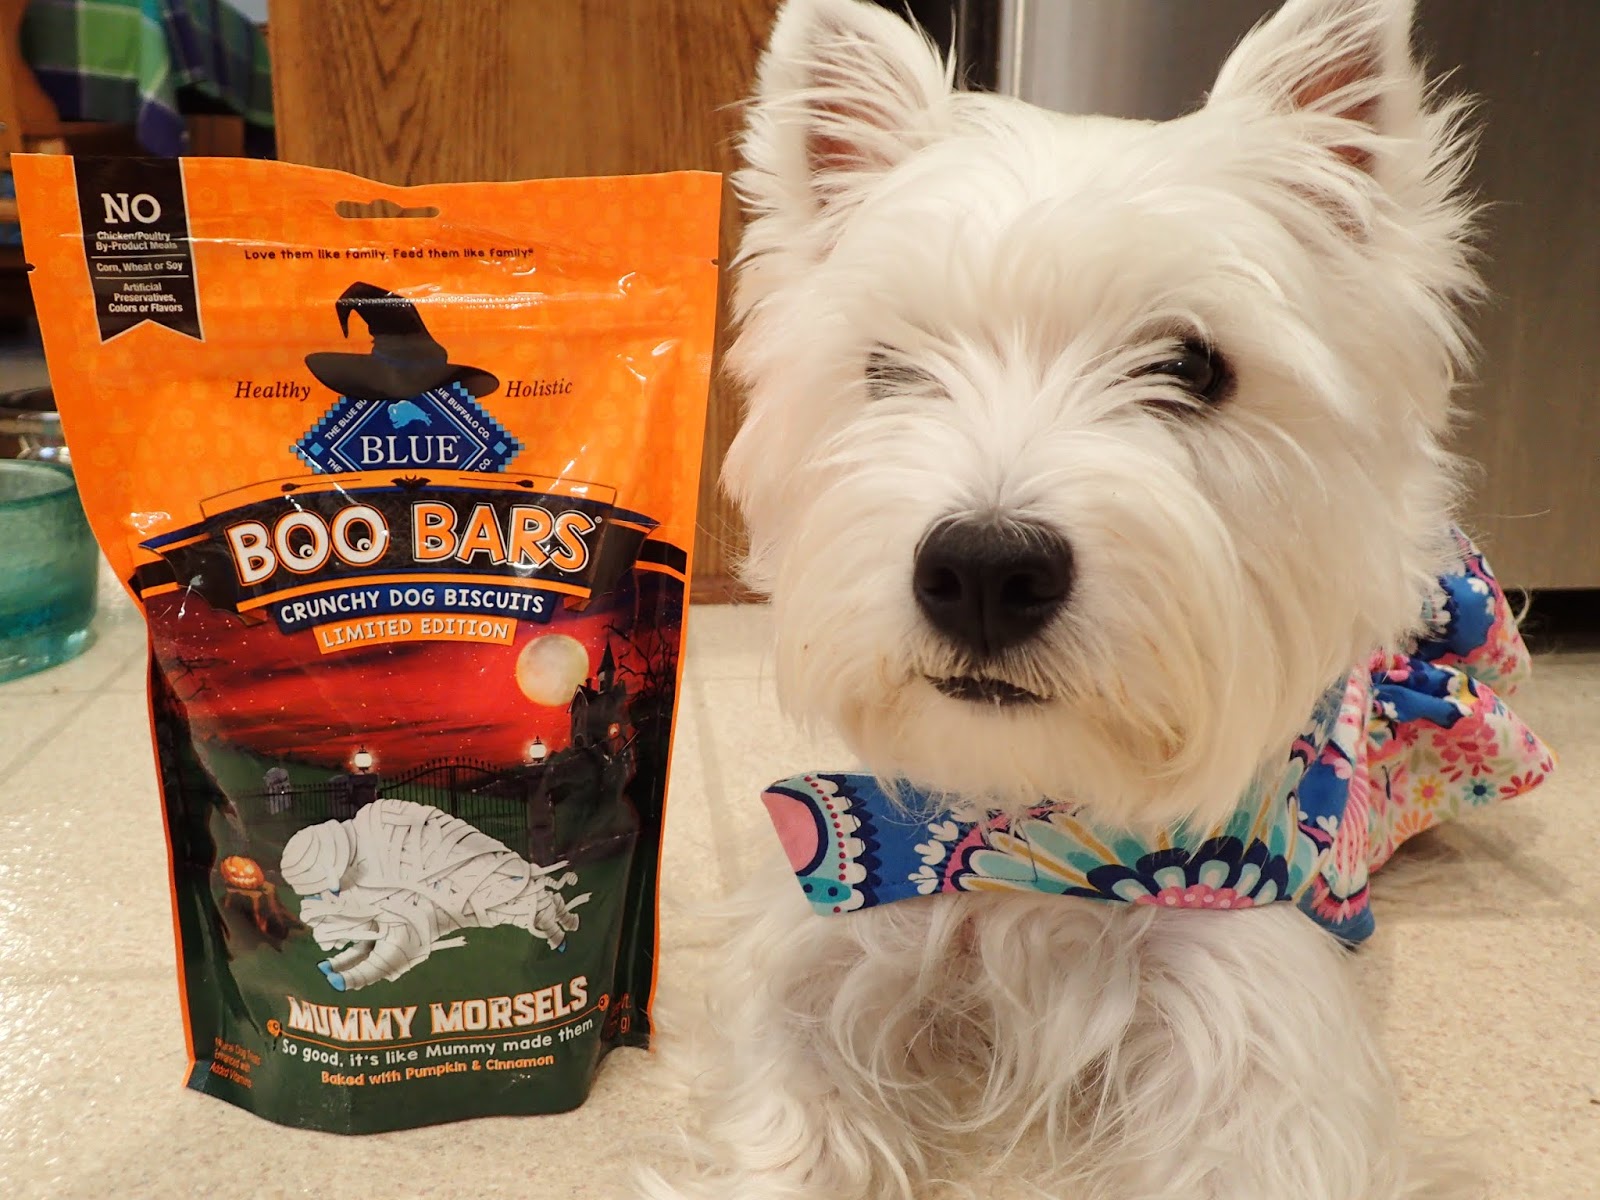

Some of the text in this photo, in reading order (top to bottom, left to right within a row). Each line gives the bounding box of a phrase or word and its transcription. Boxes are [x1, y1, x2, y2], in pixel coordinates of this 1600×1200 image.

[100, 193, 162, 224] NO
[95, 240, 178, 252] By-Product Meals
[96, 231, 171, 242] Chicken/Poultry
[96, 262, 122, 273] Corn,
[122, 262, 153, 272] Wheat
[166, 260, 183, 272] Soy
[244, 249, 276, 260] Love
[281, 249, 314, 259] them
[318, 249, 341, 259] like
[393, 248, 423, 258] Feed
[428, 249, 460, 258] them
[464, 248, 485, 257] like
[113, 293, 177, 303] Preservatives,
[123, 282, 162, 291] Artificial
[108, 303, 183, 313] Colors or Flavors
[234, 381, 311, 402] Healthy
[505, 378, 573, 398] Holistic
[324, 424, 341, 440] THE
[338, 407, 358, 428] BLUE
[447, 397, 480, 429] BUFFALO
[224, 503, 390, 587] BOO
[280, 588, 545, 624] CRUNCHY DOG BISCUITS
[322, 617, 510, 648] LIMITED EDITION
[287, 995, 418, 1042] MUMMY
[428, 975, 589, 1035] MORSELS
[282, 1038, 298, 1056] So
[350, 1053, 380, 1067] it's
[385, 1051, 419, 1064] like
[425, 1043, 496, 1058] Mummy
[503, 1034, 553, 1052] made
[557, 1018, 594, 1043] them
[321, 1054, 555, 1086] Baked with Pumpkin & Cinnamon
